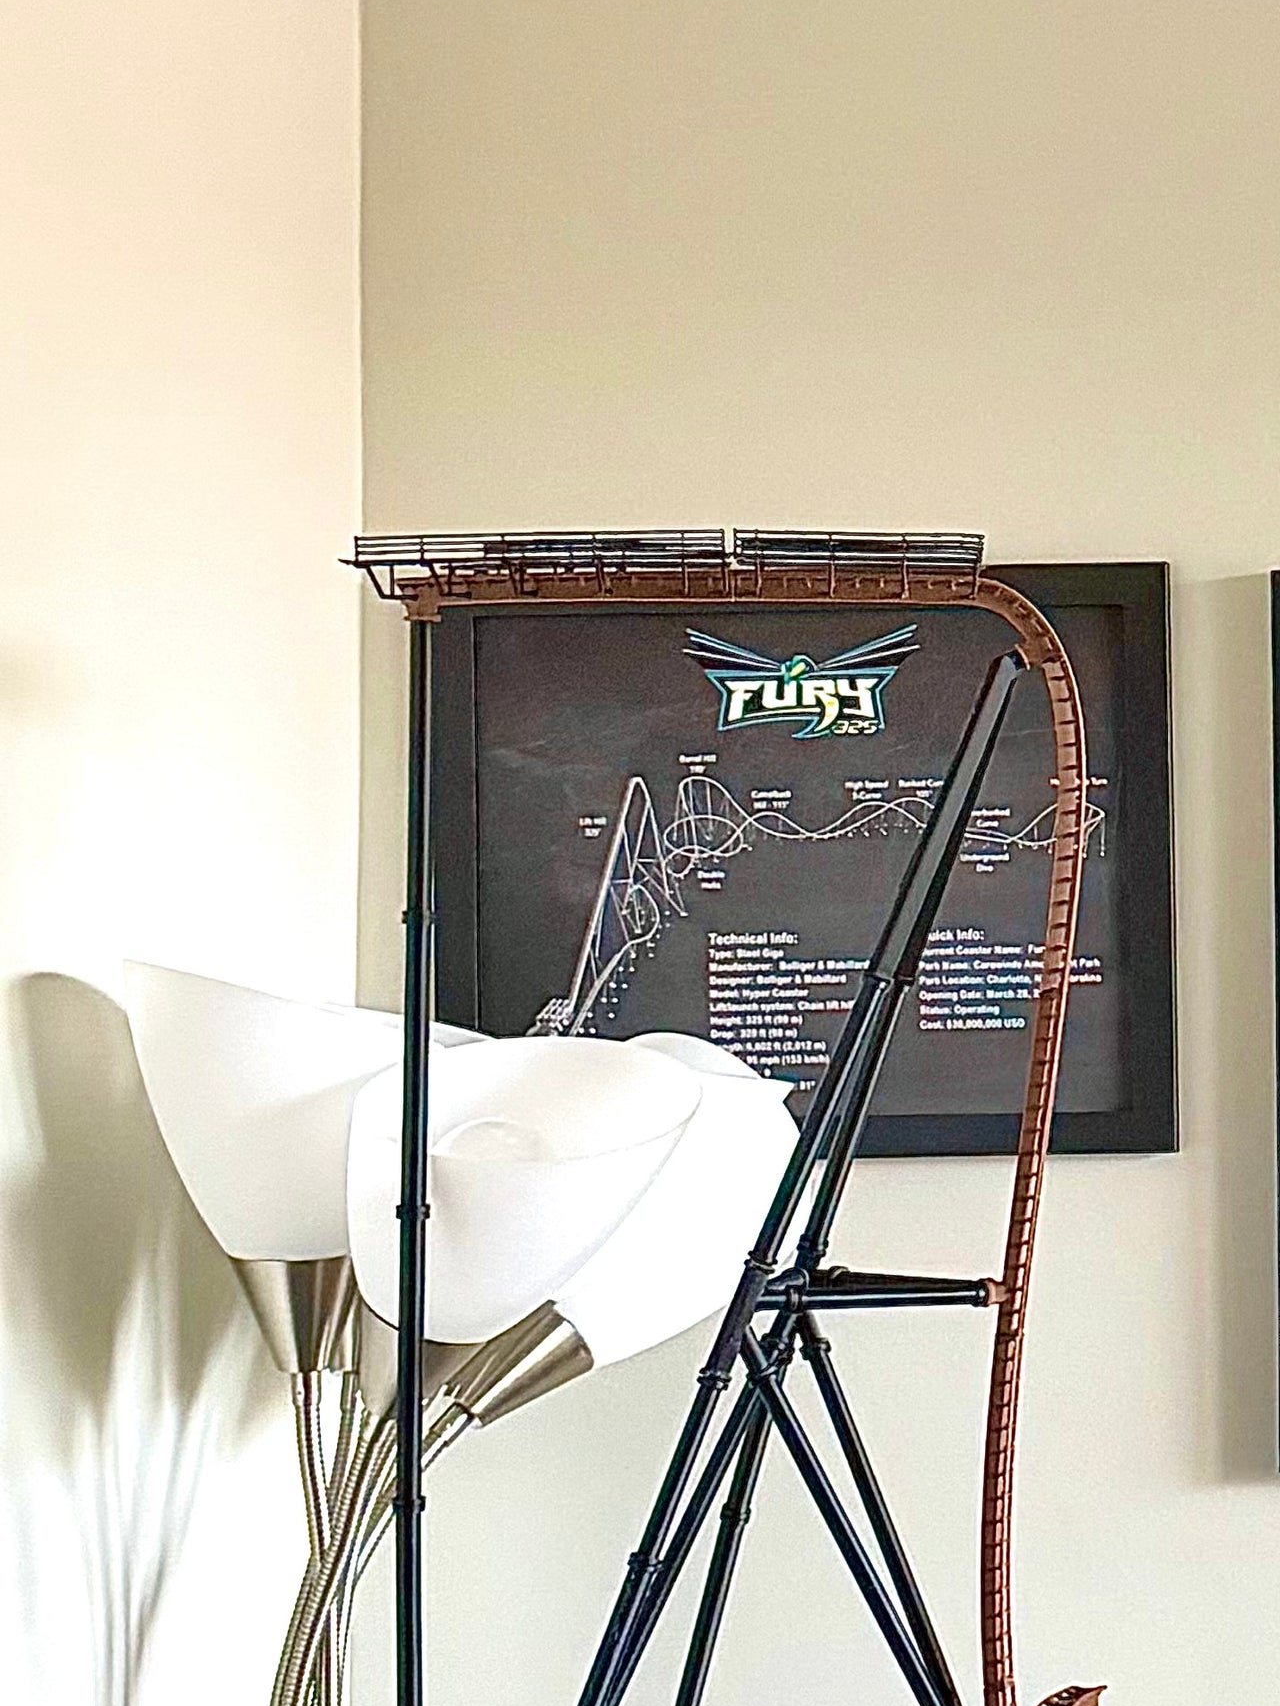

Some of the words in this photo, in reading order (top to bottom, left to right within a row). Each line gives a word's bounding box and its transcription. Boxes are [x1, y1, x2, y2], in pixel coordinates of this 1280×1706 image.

[725, 678, 880, 732] FURY
[833, 720, 880, 734] 325
[708, 933, 768, 945] Technical
[770, 933, 798, 944] Info:
[928, 930, 953, 941] uick
[957, 929, 984, 941] Info:
[709, 949, 734, 960] Type:
[737, 949, 760, 958] Steel
[922, 946, 954, 956] urrent
[956, 945, 992, 955] Coaster
[818, 960, 824, 969] &
[919, 962, 940, 971] Park
[1080, 958, 1100, 967] Park
[795, 975, 802, 984] &
[919, 976, 940, 985] Park
[942, 975, 985, 985] Location:
[709, 989, 739, 998] Model:
[742, 989, 770, 1000] Hyper
[772, 989, 809, 998] Coaster
[919, 991, 958, 1001] Opening
[987, 989, 1014, 998] March
[919, 1005, 952, 1015] Status:
[954, 1005, 1000, 1015] Operating
